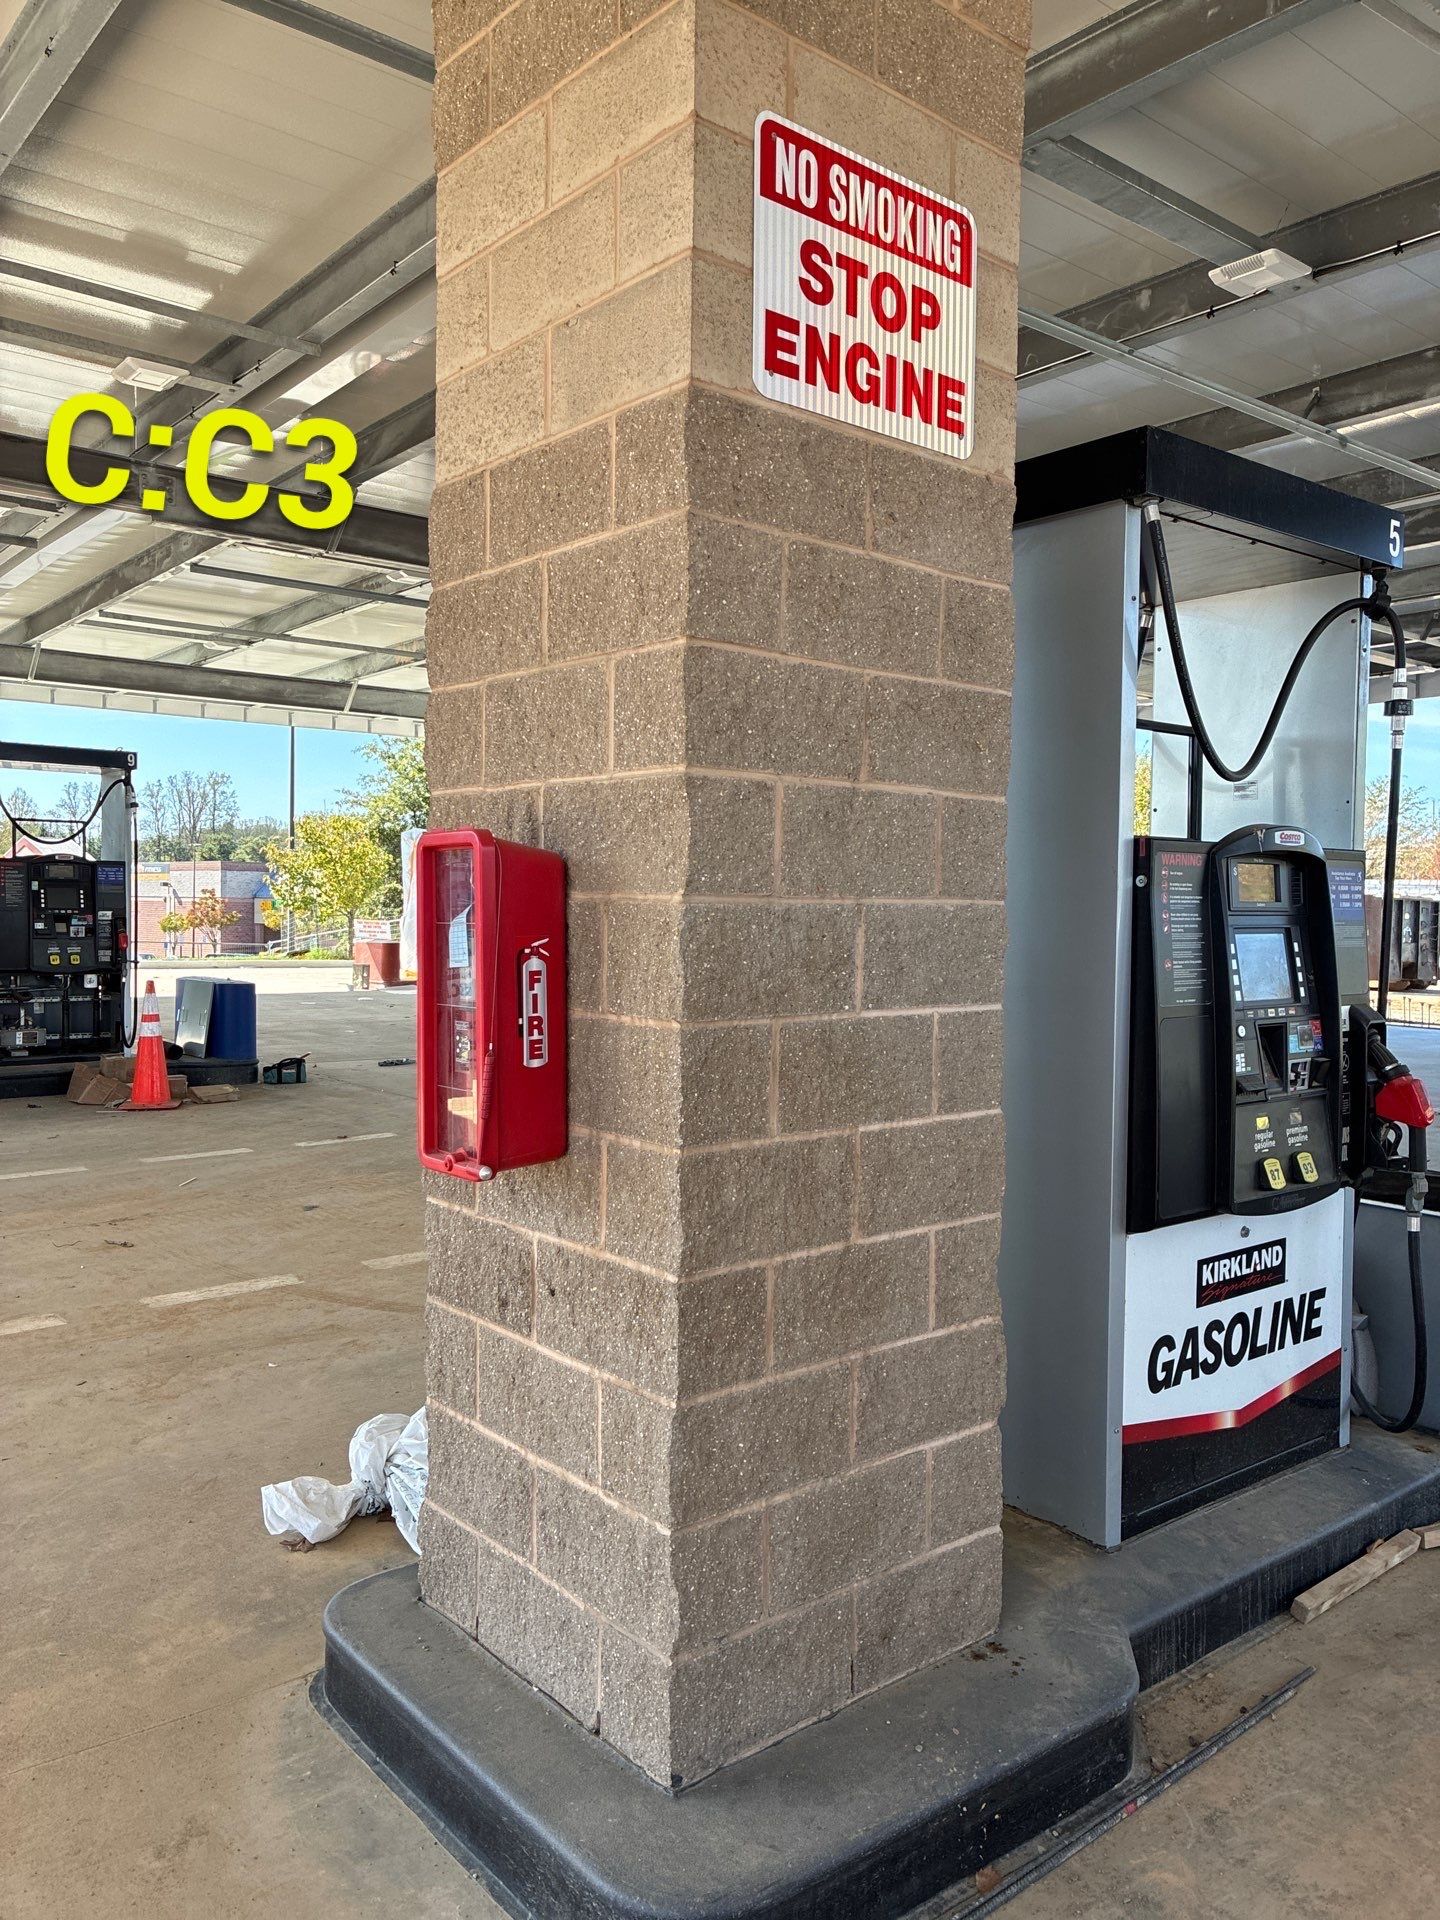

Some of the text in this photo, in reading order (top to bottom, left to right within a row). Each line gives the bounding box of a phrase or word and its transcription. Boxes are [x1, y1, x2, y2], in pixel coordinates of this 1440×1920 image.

[775, 135, 961, 274] NO SMOKING
[798, 239, 942, 344] STOP
[764, 308, 966, 436] ENGINE
[1389, 518, 1400, 558] 5
[127, 753, 135, 767] 9
[1161, 853, 1203, 867] WARNING
[528, 969, 544, 1061] FIRE
[1254, 1130, 1274, 1142] regular
[1285, 1125, 1309, 1137] premium
[1287, 1134, 1309, 1146] gasoline
[1254, 1139, 1276, 1152] gasoline
[1269, 1168, 1281, 1180] 87
[1302, 1162, 1314, 1174] 93
[1202, 1245, 1283, 1287] KIRKLAND
[1201, 1273, 1283, 1305] Signature
[1147, 1287, 1327, 1394] GASOLINE
